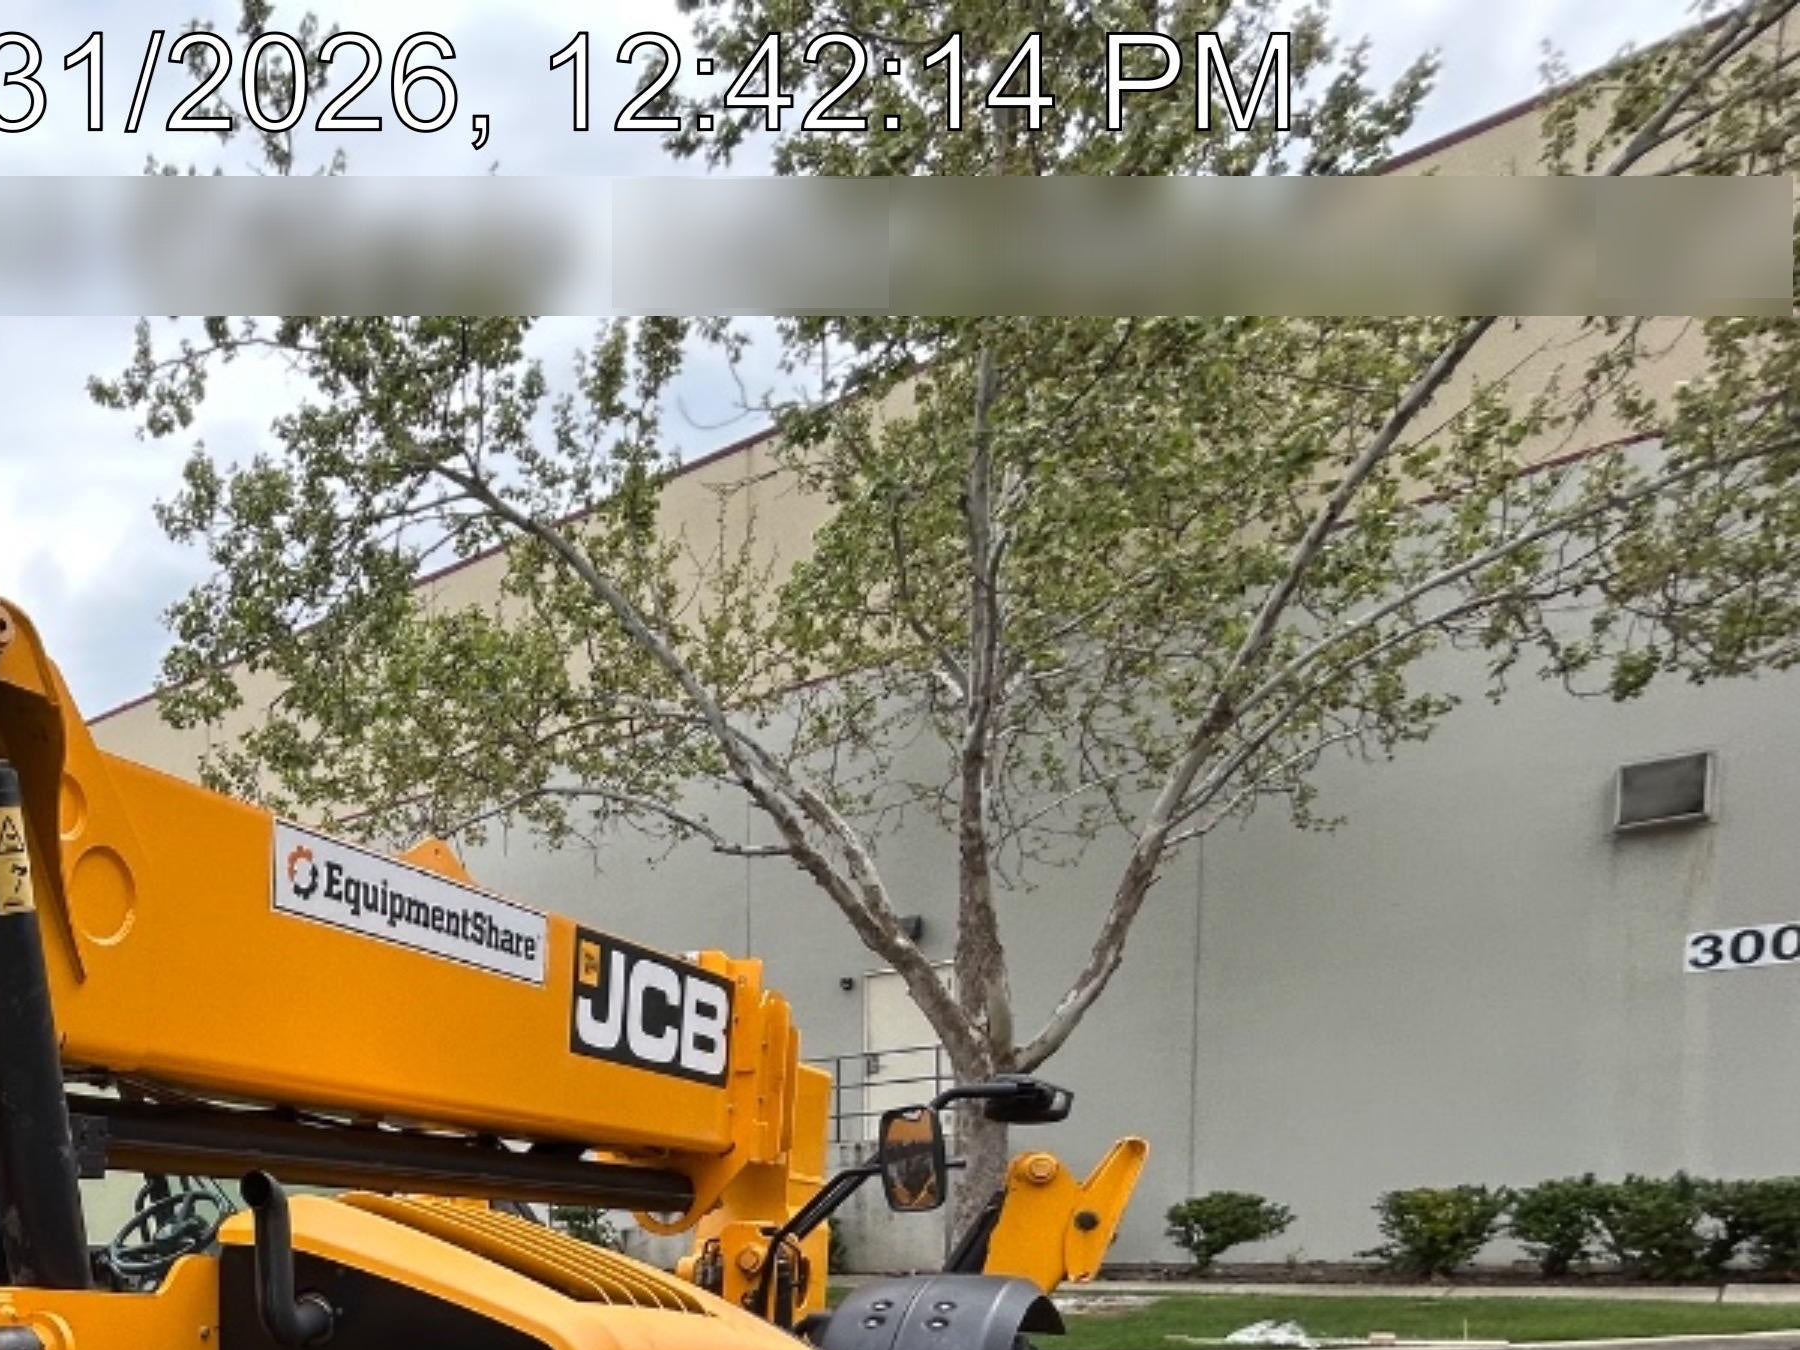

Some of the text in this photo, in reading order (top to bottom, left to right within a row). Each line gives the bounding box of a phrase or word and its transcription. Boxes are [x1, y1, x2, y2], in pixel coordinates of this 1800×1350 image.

[323, 860, 536, 961] EquipmentShare
[1688, 923, 1800, 969] 300
[576, 949, 730, 1075] JCB
